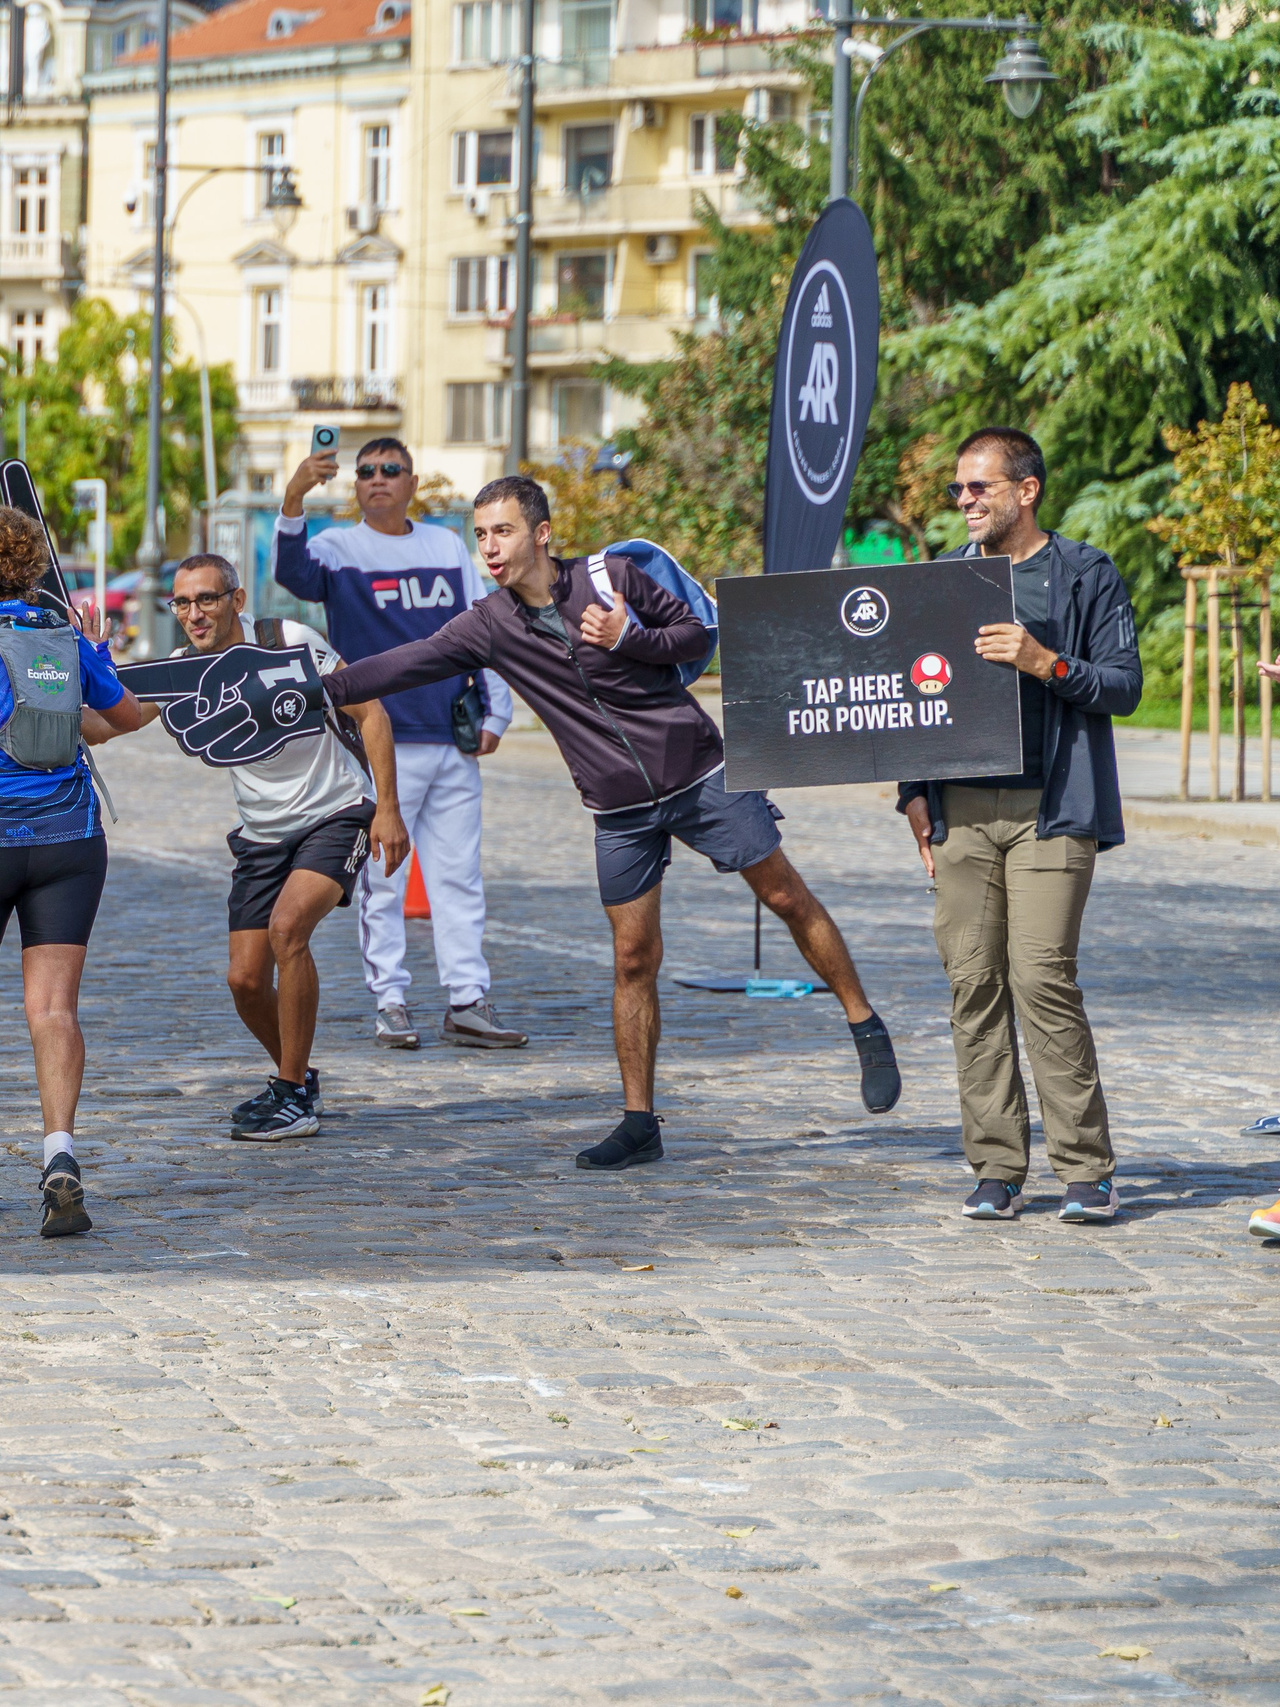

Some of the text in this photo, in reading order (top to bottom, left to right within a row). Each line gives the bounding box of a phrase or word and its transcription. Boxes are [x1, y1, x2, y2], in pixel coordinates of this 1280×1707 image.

[811, 312, 833, 328] adidas
[798, 341, 839, 425] AR
[371, 574, 455, 610] FILA
[27, 668, 70, 682] EarthDay
[802, 673, 905, 705] TAP HERE
[788, 699, 954, 735] FOR POWER UP.
